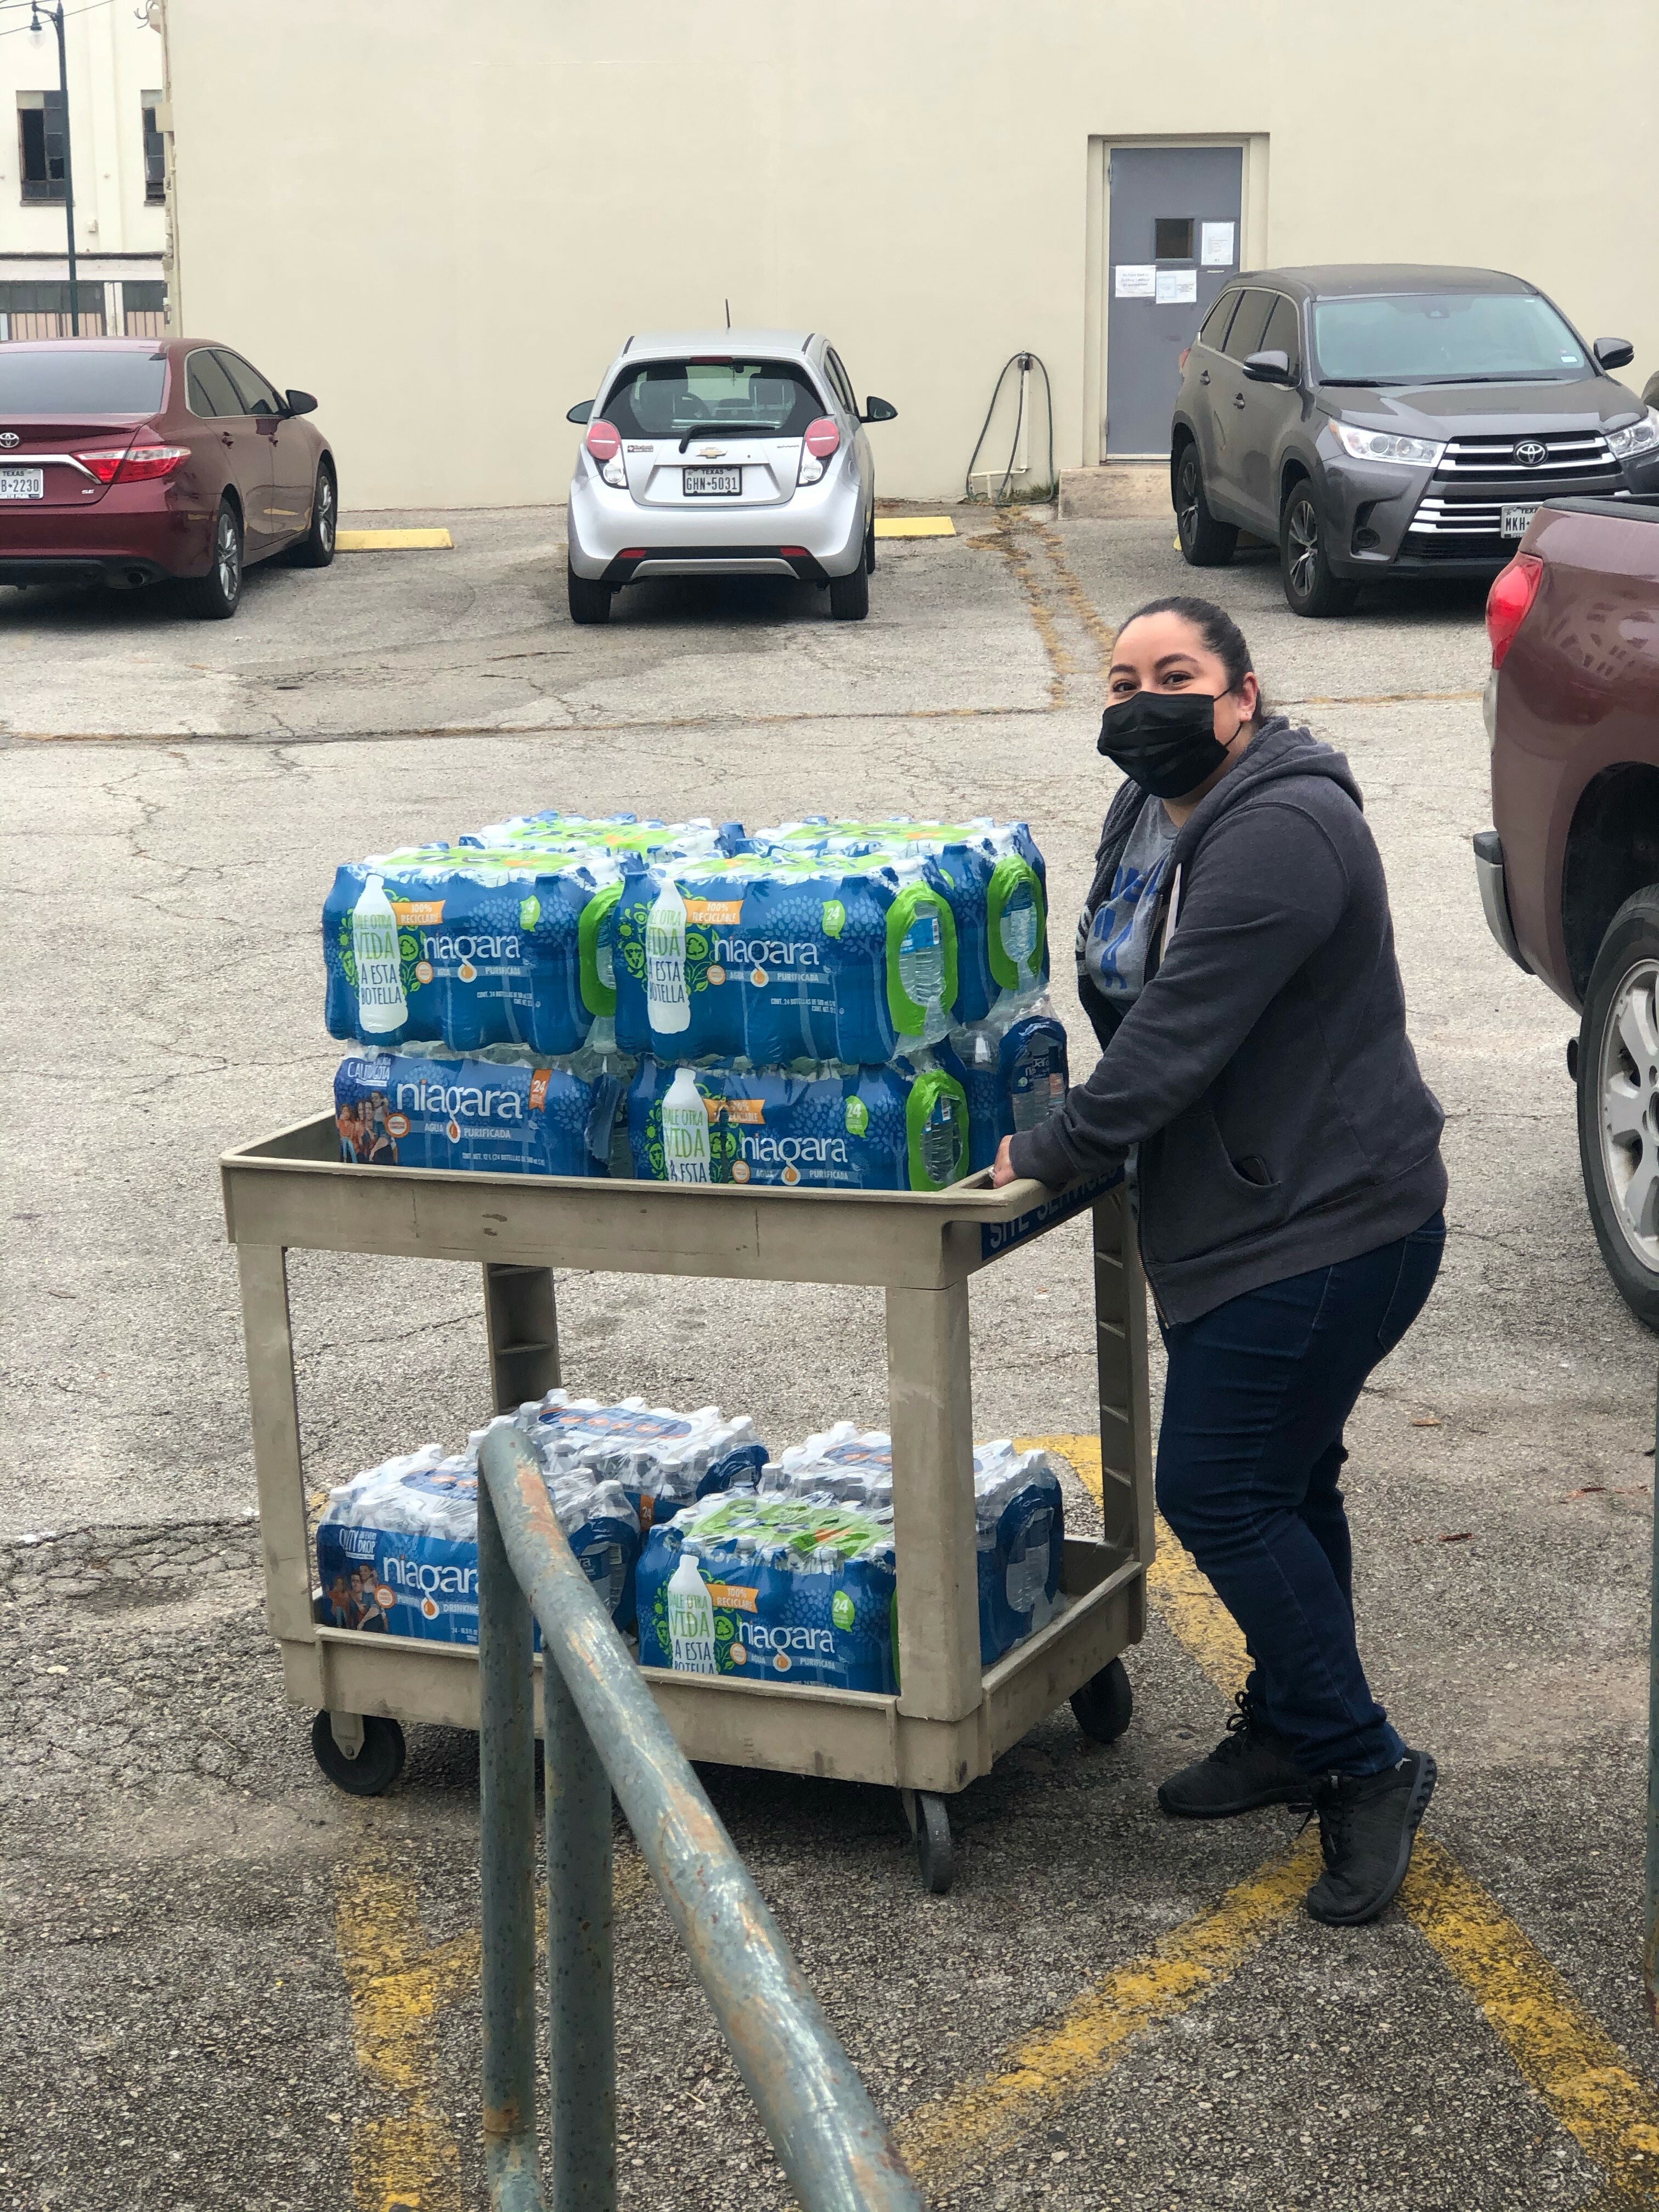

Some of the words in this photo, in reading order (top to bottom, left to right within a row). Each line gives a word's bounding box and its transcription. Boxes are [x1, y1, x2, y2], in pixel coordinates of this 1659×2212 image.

[411, 904, 433, 912] 100%
[707, 902, 729, 912] 100%
[827, 906, 840, 921] 24
[370, 914, 392, 929] OTRA
[659, 910, 681, 927] OTRA
[692, 912, 737, 922] RECICLABLE
[357, 931, 395, 960] VIDA
[424, 932, 521, 970] niagara
[714, 934, 820, 977] niagara
[361, 963, 368, 985] A
[371, 964, 397, 985] ESTA
[656, 961, 681, 982] ESTA
[777, 972, 819, 982] PURIFICADA
[361, 986, 402, 1005] BOTELLA
[532, 1079, 546, 1094] 24
[397, 1079, 523, 1131] niagara
[847, 1103, 862, 1118] 24
[682, 1109, 703, 1126] OTRA
[424, 1122, 444, 1133] AGUA
[464, 1127, 512, 1139] PURIFICADA
[665, 1127, 705, 1158] VIDA
[741, 1132, 848, 1174] niagara
[670, 1159, 678, 1182] A
[756, 1169, 774, 1178] AGUA
[809, 1169, 849, 1180] PURIFICADA
[642, 1506, 652, 1520] 24
[358, 1539, 376, 1554] DROP
[686, 1594, 709, 1609] OTRA
[727, 1587, 747, 1599] 100%
[833, 1598, 848, 1613] 24
[670, 1610, 710, 1638] VIDA
[675, 1639, 682, 1659] A
[686, 1641, 712, 1661] ESTA
[738, 1620, 835, 1663] niagara
[799, 1657, 836, 1669] PURIFICADA
